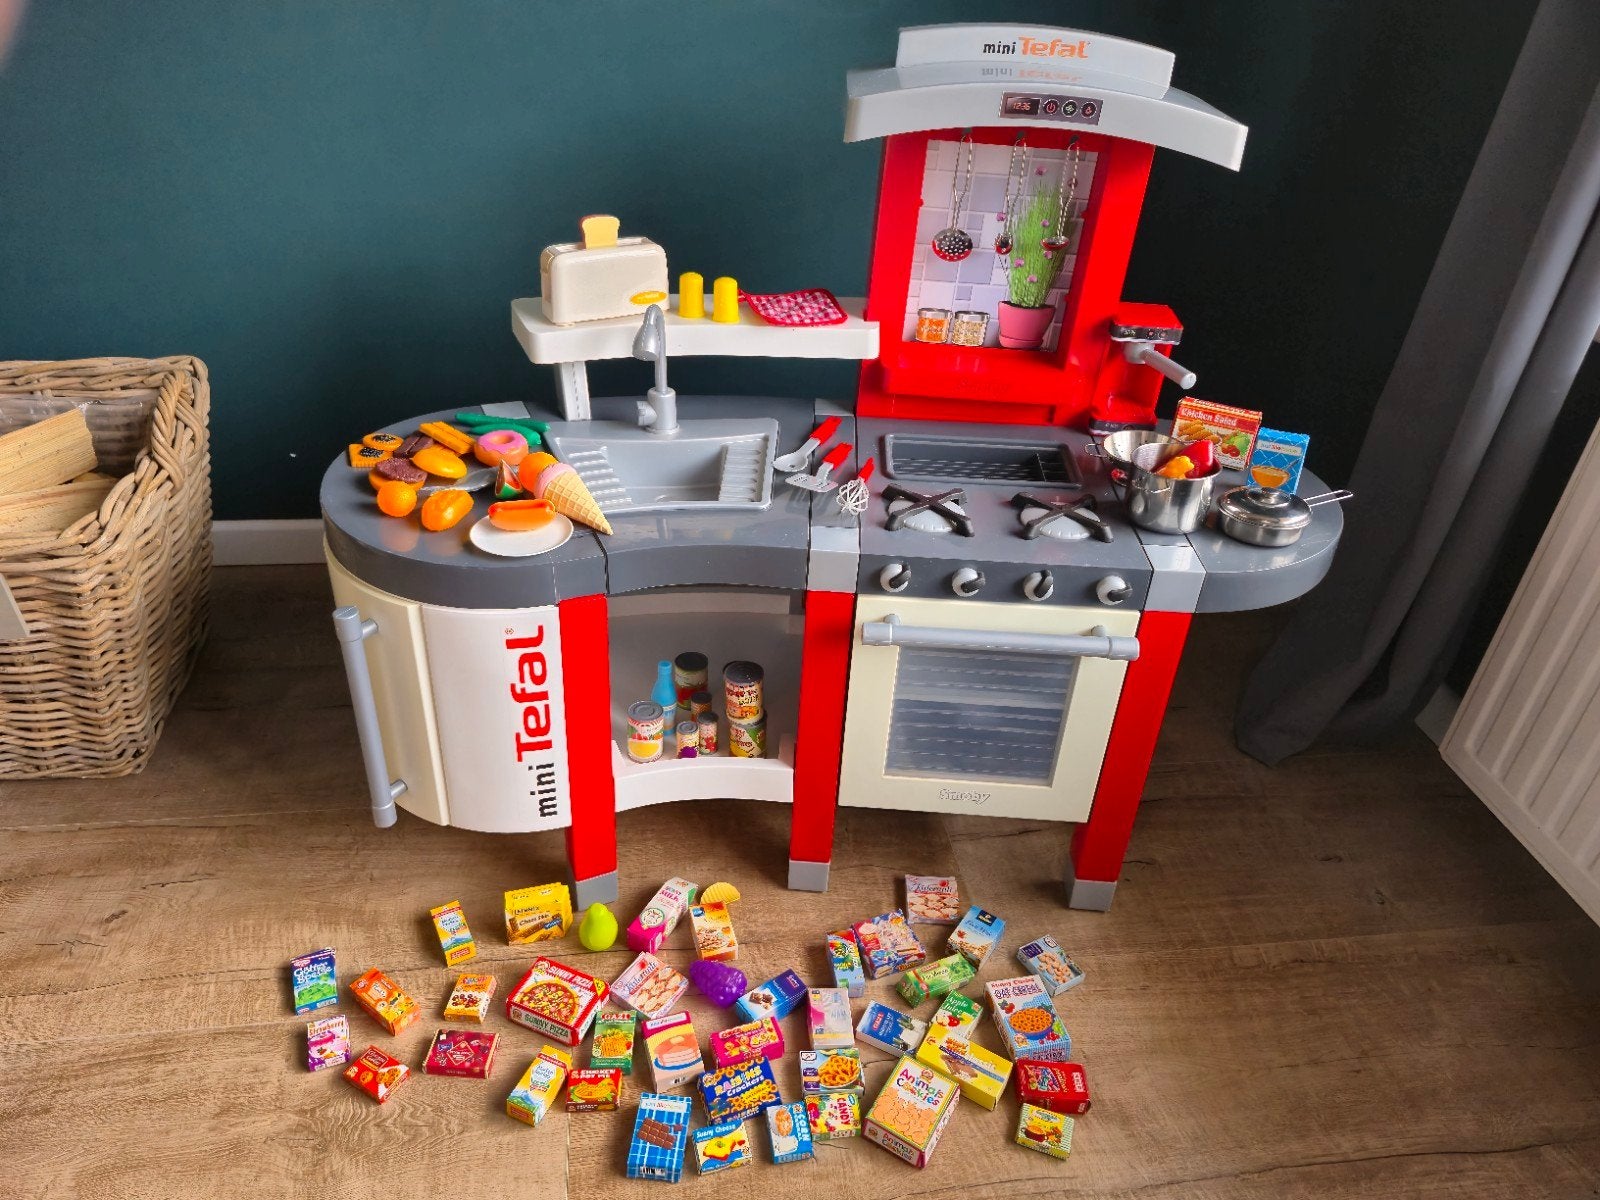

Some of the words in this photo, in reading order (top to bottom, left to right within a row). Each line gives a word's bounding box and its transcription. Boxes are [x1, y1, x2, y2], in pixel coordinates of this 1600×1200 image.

[983, 41, 1016, 54] mini
[1018, 36, 1088, 58] Tefal
[505, 625, 553, 762] Tefal
[528, 763, 557, 817] mini
[948, 997, 968, 1008] Apple
[524, 1013, 549, 1029] SUNNY
[549, 1024, 569, 1038] PIZZA
[837, 1097, 850, 1125] CANDY
[797, 1114, 811, 1142] CORN
